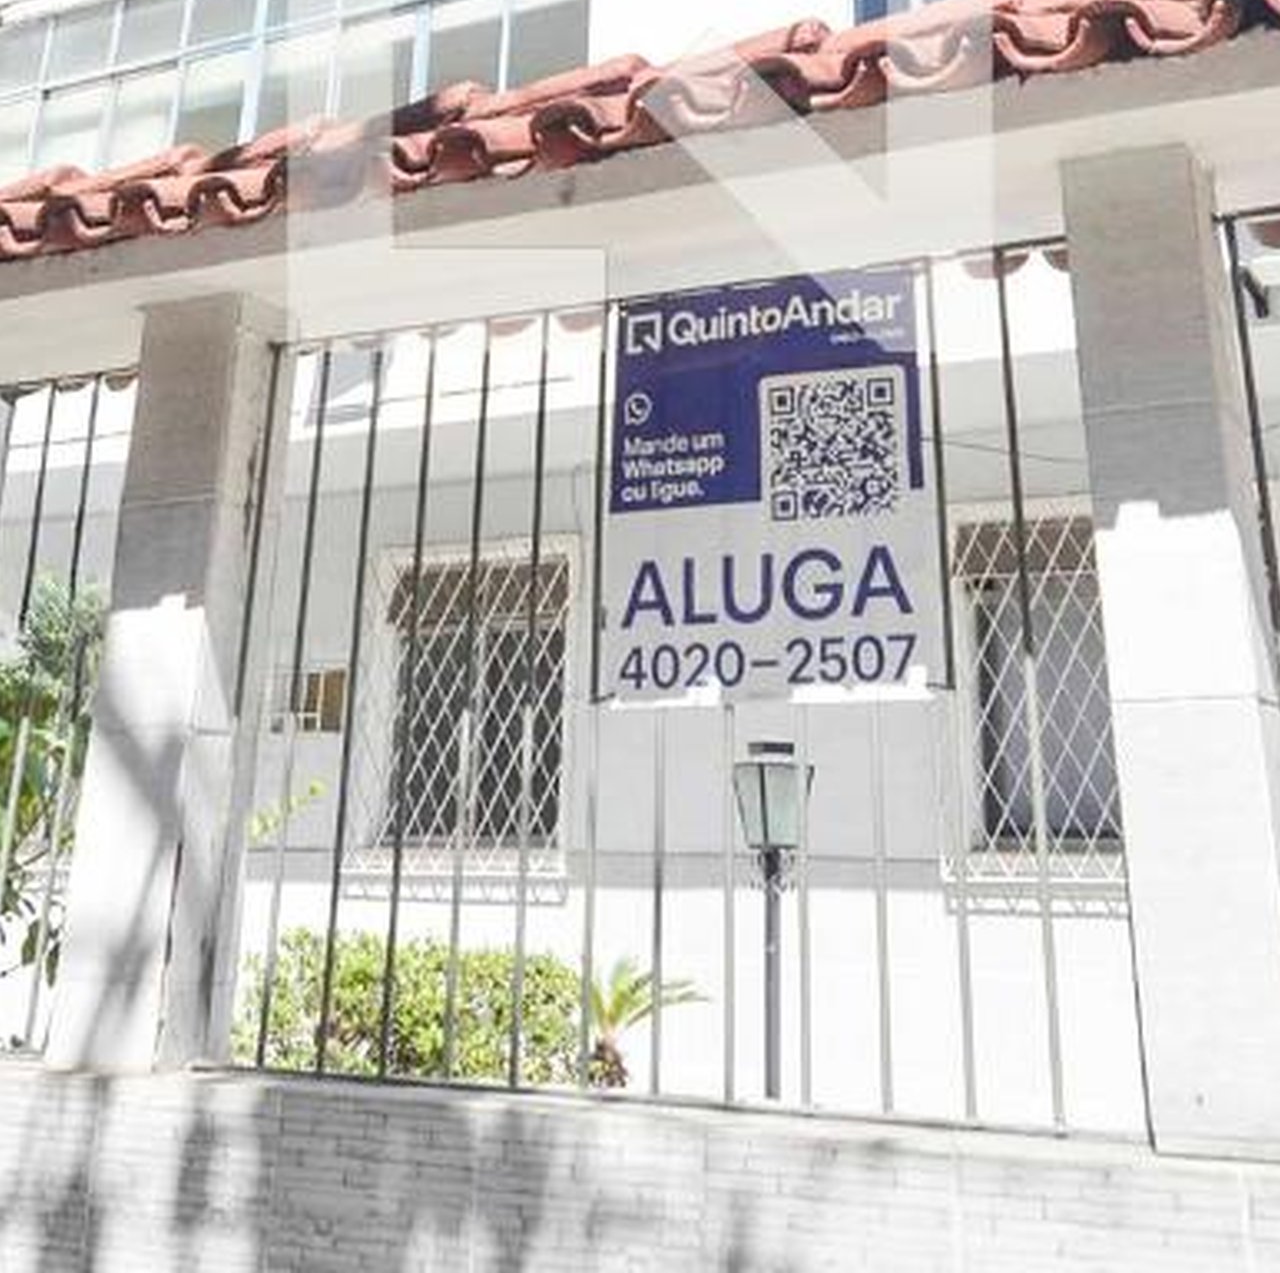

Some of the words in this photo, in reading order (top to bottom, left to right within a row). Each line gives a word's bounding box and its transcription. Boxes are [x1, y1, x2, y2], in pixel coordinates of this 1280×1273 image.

[670, 289, 902, 345] QuintoAndar
[623, 434, 689, 456] Mande
[691, 432, 725, 451] um
[621, 544, 914, 629] ALUGA
[619, 633, 918, 691] 4020-2507
